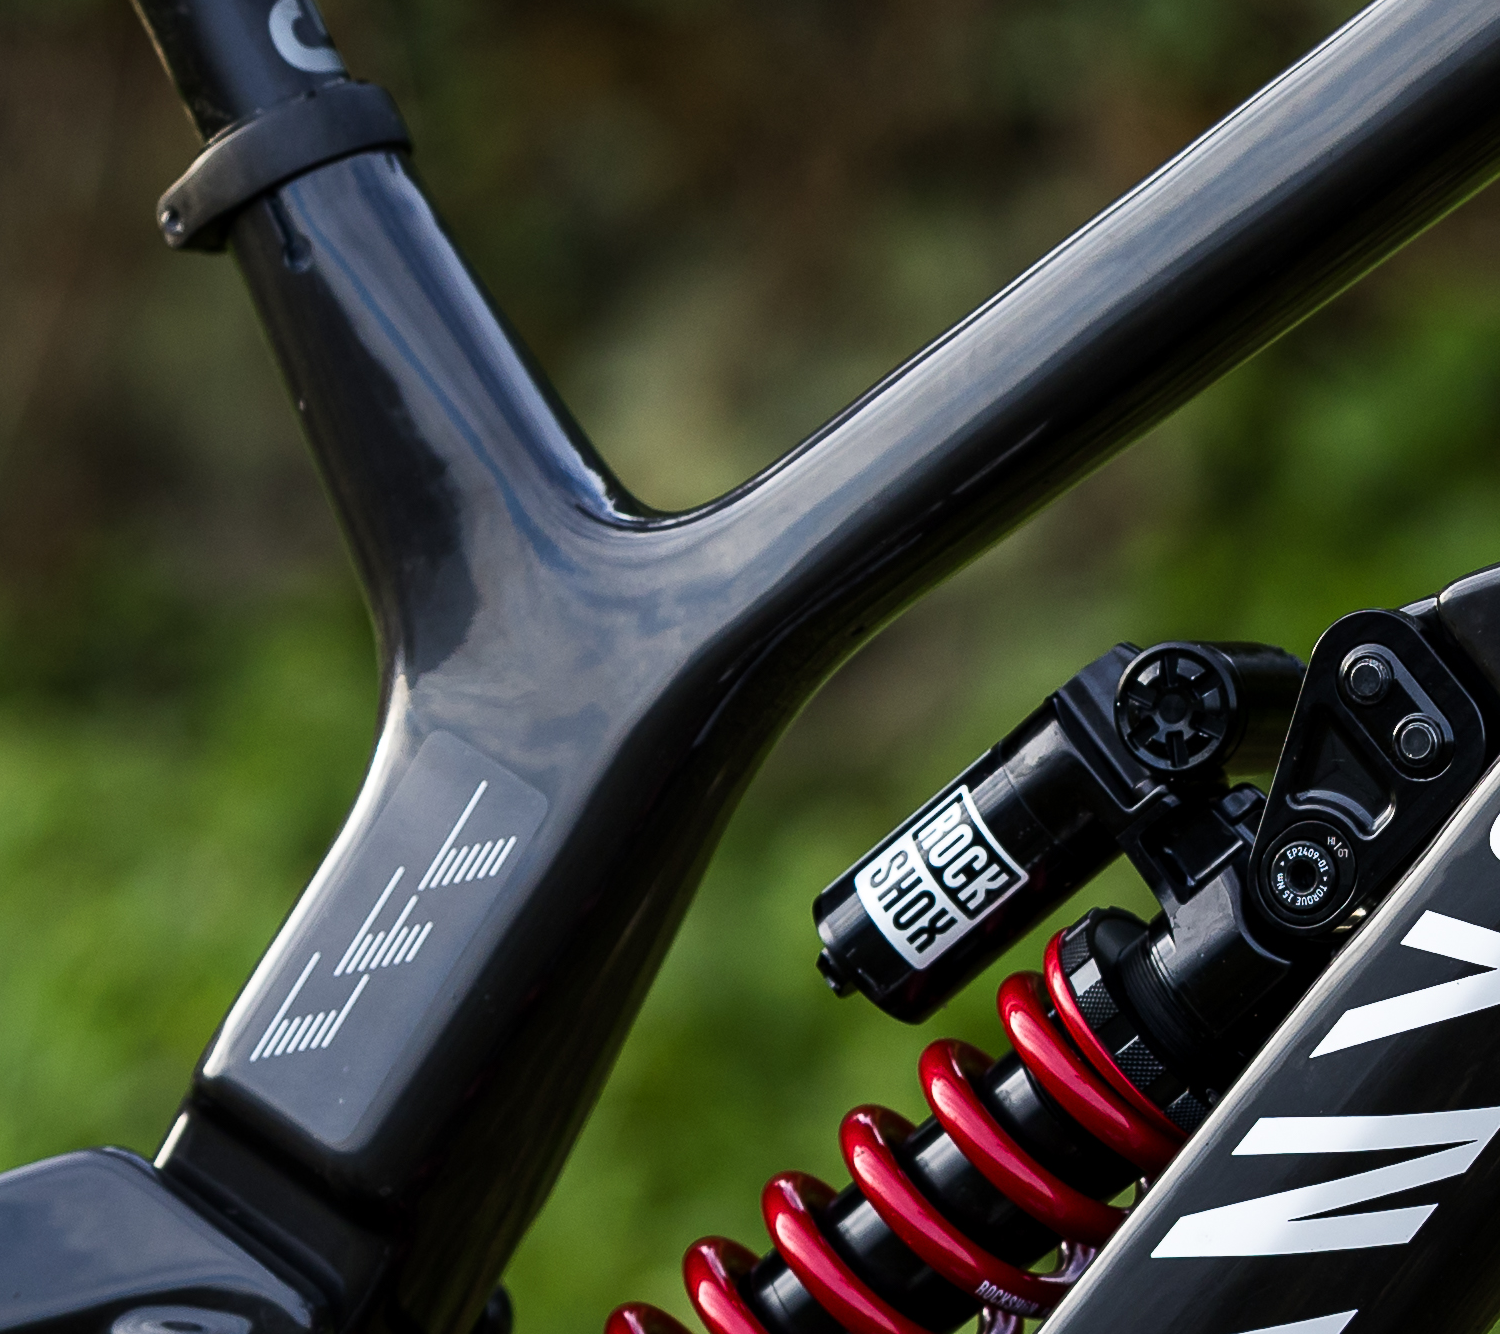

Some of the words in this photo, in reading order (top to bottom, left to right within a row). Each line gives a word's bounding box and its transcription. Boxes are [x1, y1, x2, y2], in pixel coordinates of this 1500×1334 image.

[917, 801, 1010, 911] ROCK
[1286, 846, 1329, 873] EP2409-01
[869, 849, 959, 954] SHOX
[1282, 890, 1295, 903] 15
[1295, 884, 1328, 906] TORQUE
